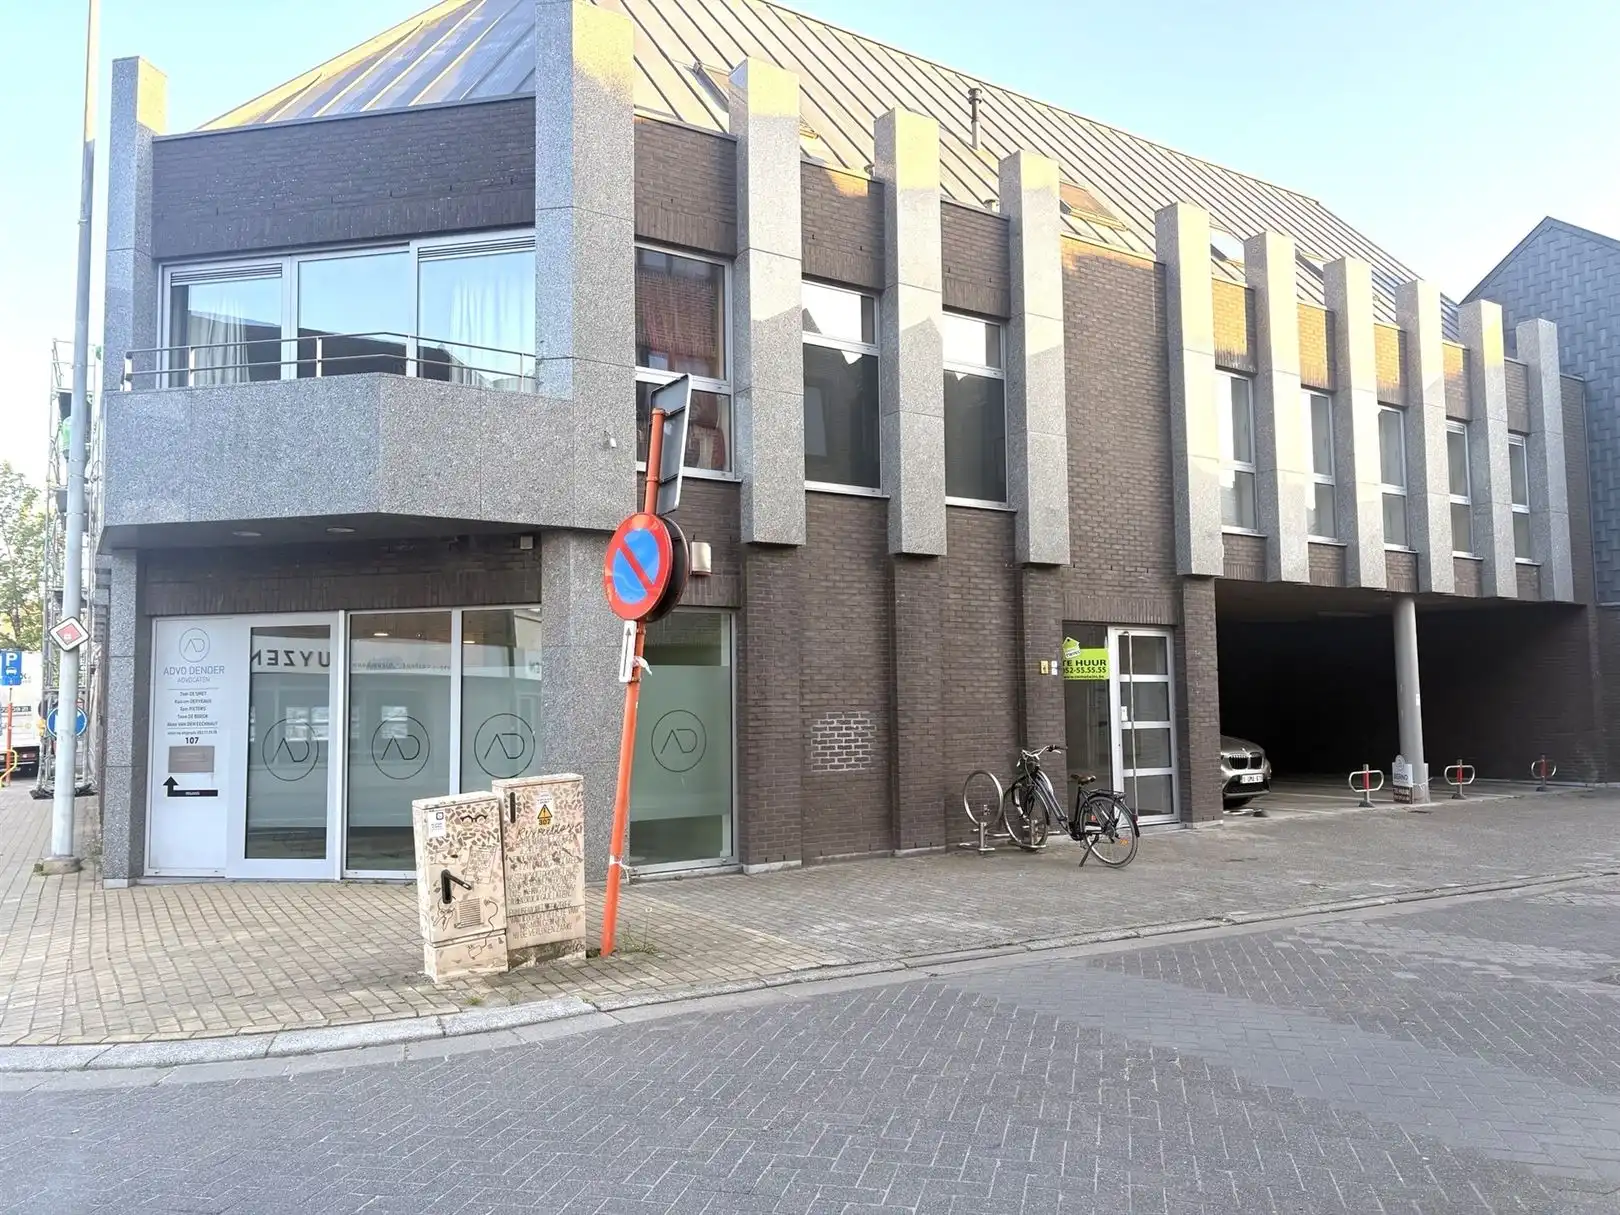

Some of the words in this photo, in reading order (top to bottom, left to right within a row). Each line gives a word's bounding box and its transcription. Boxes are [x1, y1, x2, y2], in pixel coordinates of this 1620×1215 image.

[6, 653, 18, 666] P
[163, 666, 187, 676] ADVO
[189, 665, 226, 675] DENDER
[185, 736, 200, 745] 107
